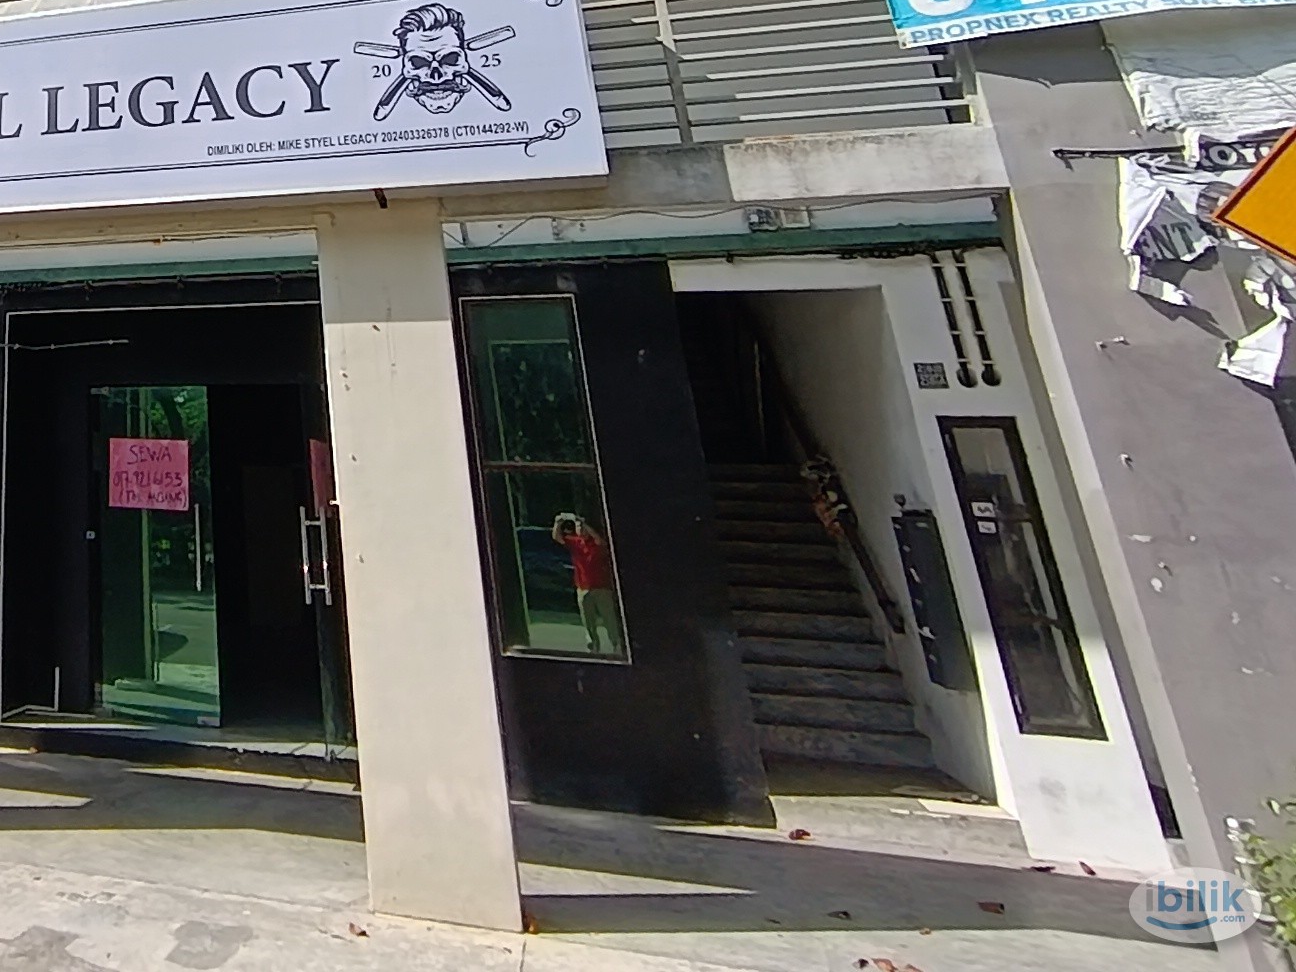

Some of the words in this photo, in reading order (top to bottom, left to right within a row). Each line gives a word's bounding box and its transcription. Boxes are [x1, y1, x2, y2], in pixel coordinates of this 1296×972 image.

[910, 12, 1041, 44] PROPNEX
[372, 65, 391, 78] 20
[480, 53, 501, 68] 25
[41, 59, 340, 135] LEGACY
[247, 141, 276, 153] OLEH:
[278, 139, 302, 150] MIKE
[304, 137, 335, 148] STYEL
[338, 133, 378, 146] LEGACY
[127, 444, 172, 465] SEWA
